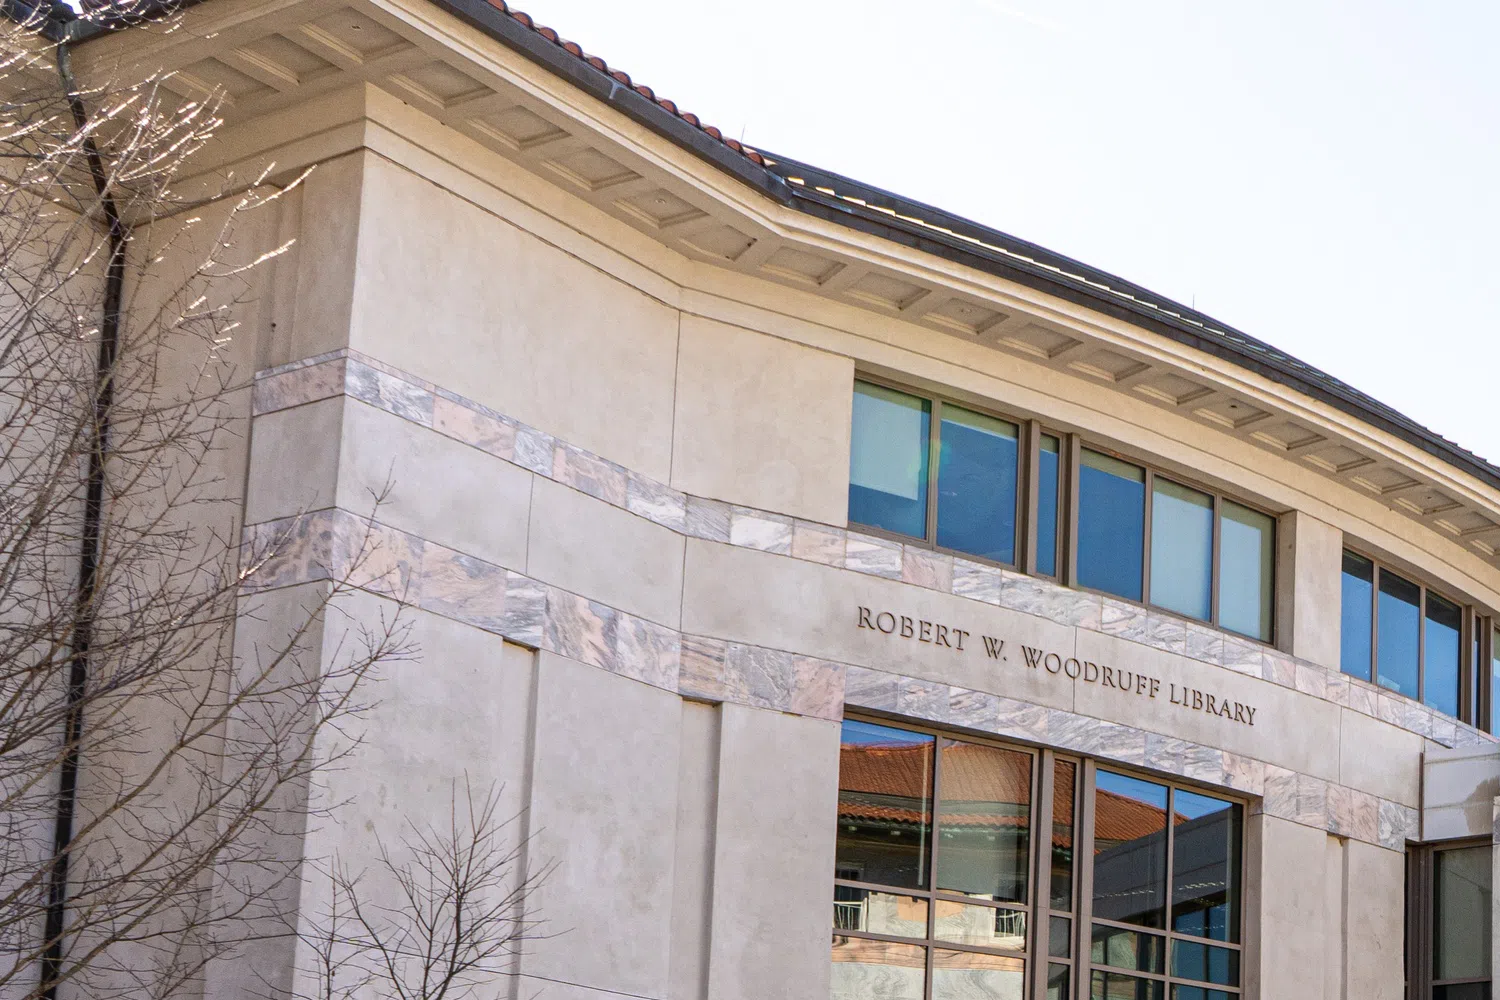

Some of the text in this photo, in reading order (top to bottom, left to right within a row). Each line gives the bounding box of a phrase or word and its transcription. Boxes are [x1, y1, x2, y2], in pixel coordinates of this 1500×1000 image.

[858, 606, 1257, 726] ROBERT W. WOODRUFF LIBRARY
